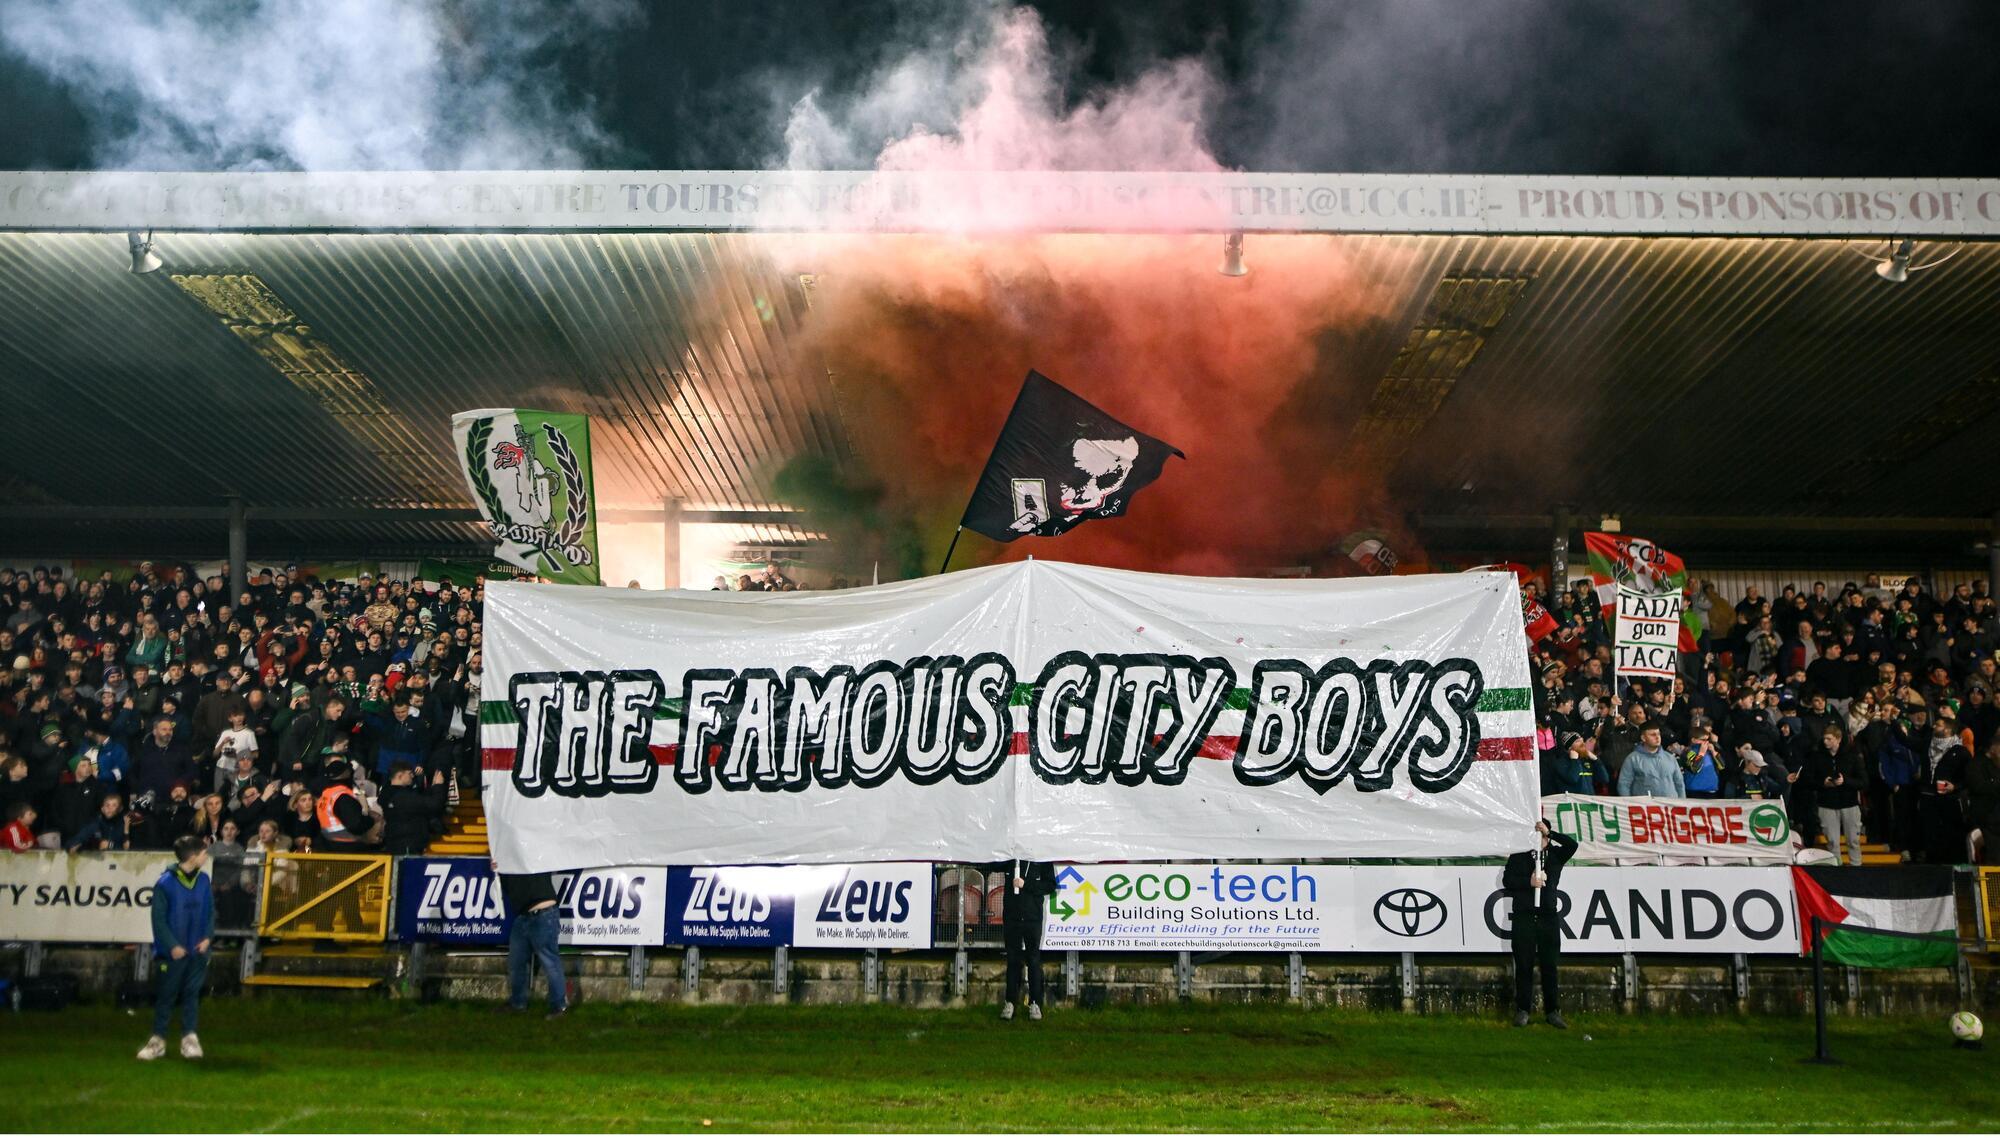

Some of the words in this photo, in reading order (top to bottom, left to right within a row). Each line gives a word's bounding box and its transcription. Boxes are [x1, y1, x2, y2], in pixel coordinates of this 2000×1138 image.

[446, 183, 608, 214] CENTRE
[619, 183, 760, 214] TOURS
[1518, 189, 1665, 220] PROUD
[1676, 190, 1897, 221] SPONSORS
[1909, 191, 1963, 221] OF
[1882, 579, 1906, 588] BLOC
[1619, 593, 1680, 618] TADA
[1632, 623, 1666, 640] gan
[1616, 645, 1677, 671] TACA
[509, 669, 665, 797] THE
[674, 652, 1016, 794] FAMOUS
[1028, 651, 1237, 787] CITY
[1232, 657, 1483, 796] BOYS
[1556, 802, 1620, 843] CITY
[1628, 805, 1748, 846] BRIGADE
[417, 864, 502, 919] Zeus
[552, 868, 646, 919] Zeus
[683, 867, 771, 922] Zeus
[816, 868, 912, 923] Zeus
[1104, 866, 1317, 902] eco-tech
[1108, 906, 1184, 923] Building
[1190, 906, 1279, 920] Solutions
[1285, 907, 1320, 920] Ltd.
[1484, 888, 1784, 941] GRANDO
[443, 923, 452, 934] We
[452, 923, 471, 937] Supply.
[472, 923, 481, 934] We
[481, 923, 502, 934] Deliver.
[577, 924, 587, 935] We
[587, 924, 608, 937] Supply.
[609, 924, 619, 935] We
[619, 924, 641, 935] Deliver.
[683, 925, 692, 936] We
[692, 925, 709, 937] Make.
[709, 925, 719, 937] We
[719, 925, 740, 940] Supply.
[740, 926, 749, 937] We
[749, 926, 771, 937] Deliver.
[816, 927, 826, 938] We
[826, 927, 844, 939] Make.
[845, 927, 855, 939] We
[855, 927, 877, 941] Supply.
[877, 928, 887, 939] We
[887, 928, 910, 939] Deliver.
[1047, 923, 1095, 935] Energy
[1099, 923, 1156, 935] Efficient
[1161, 924, 1218, 935] Building
[1221, 924, 1243, 935] for
[1248, 924, 1271, 934] the
[1276, 925, 1320, 934] Future
[1045, 939, 1079, 947] Contact:
[1081, 939, 1095, 947] 087
[1098, 939, 1115, 947] 1718
[1117, 939, 1130, 947] 713
[1134, 940, 1159, 948] Email:
[1160, 940, 1321, 949] ecotechbuildingsolutionscork@gmail.com
